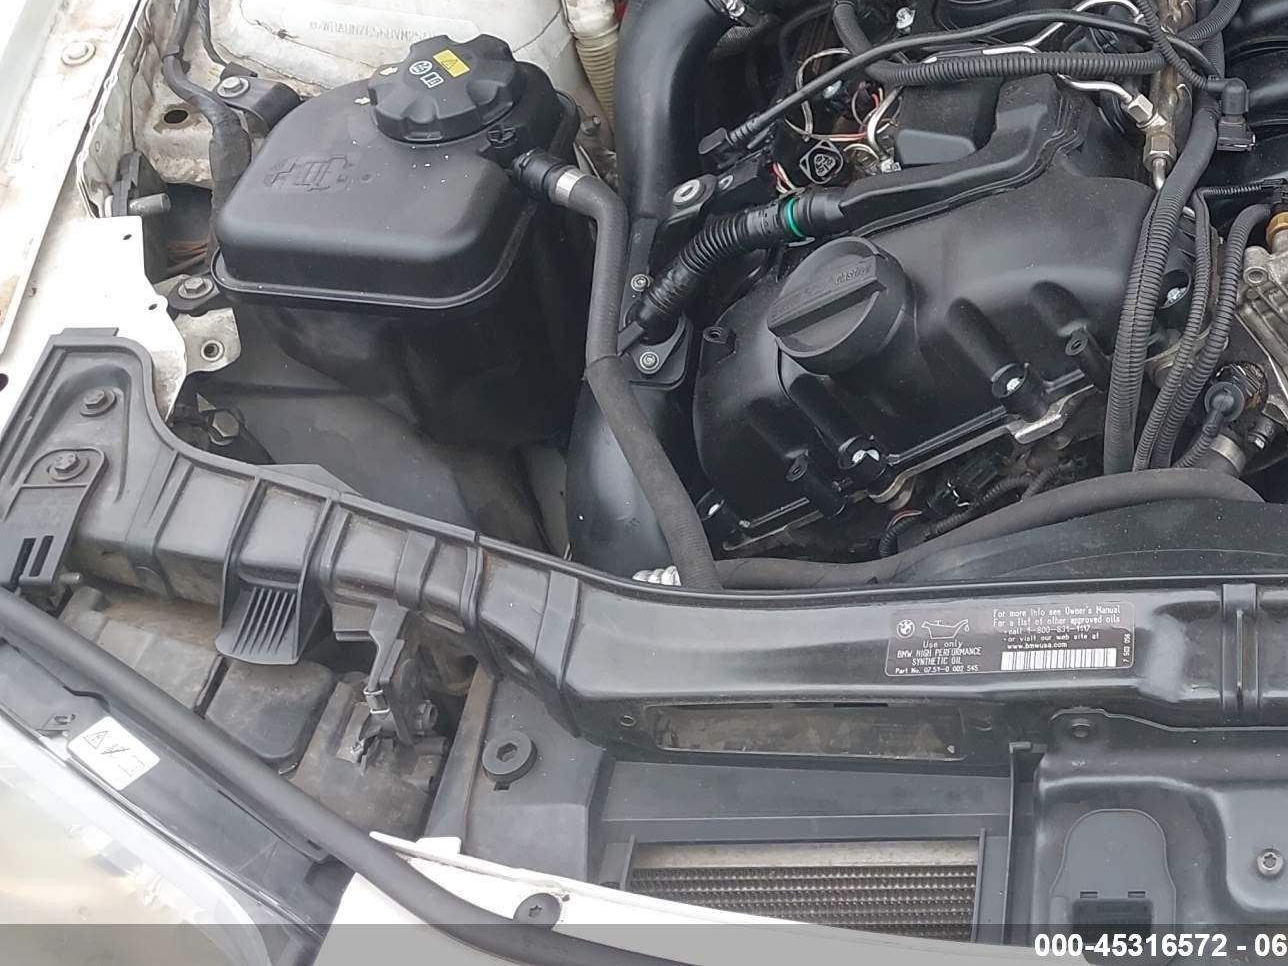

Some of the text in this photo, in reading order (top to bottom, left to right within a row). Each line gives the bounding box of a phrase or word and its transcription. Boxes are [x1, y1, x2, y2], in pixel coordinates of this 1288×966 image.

[993, 610, 1005, 618] For
[1010, 610, 1026, 618] more
[1030, 608, 1045, 616] info
[1065, 606, 1092, 615] Owner's
[1096, 605, 1120, 614] Manual
[993, 619, 1005, 627] For
[1018, 618, 1030, 626] list
[1035, 617, 1043, 625] of
[1047, 617, 1066, 625] other
[1070, 615, 1102, 626] approved
[1106, 614, 1120, 623] oils
[923, 639, 963, 649] Use only
[897, 647, 982, 658] BMW HIGH PERFORMANCE
[912, 656, 962, 666] SYNTHETIC OIL
